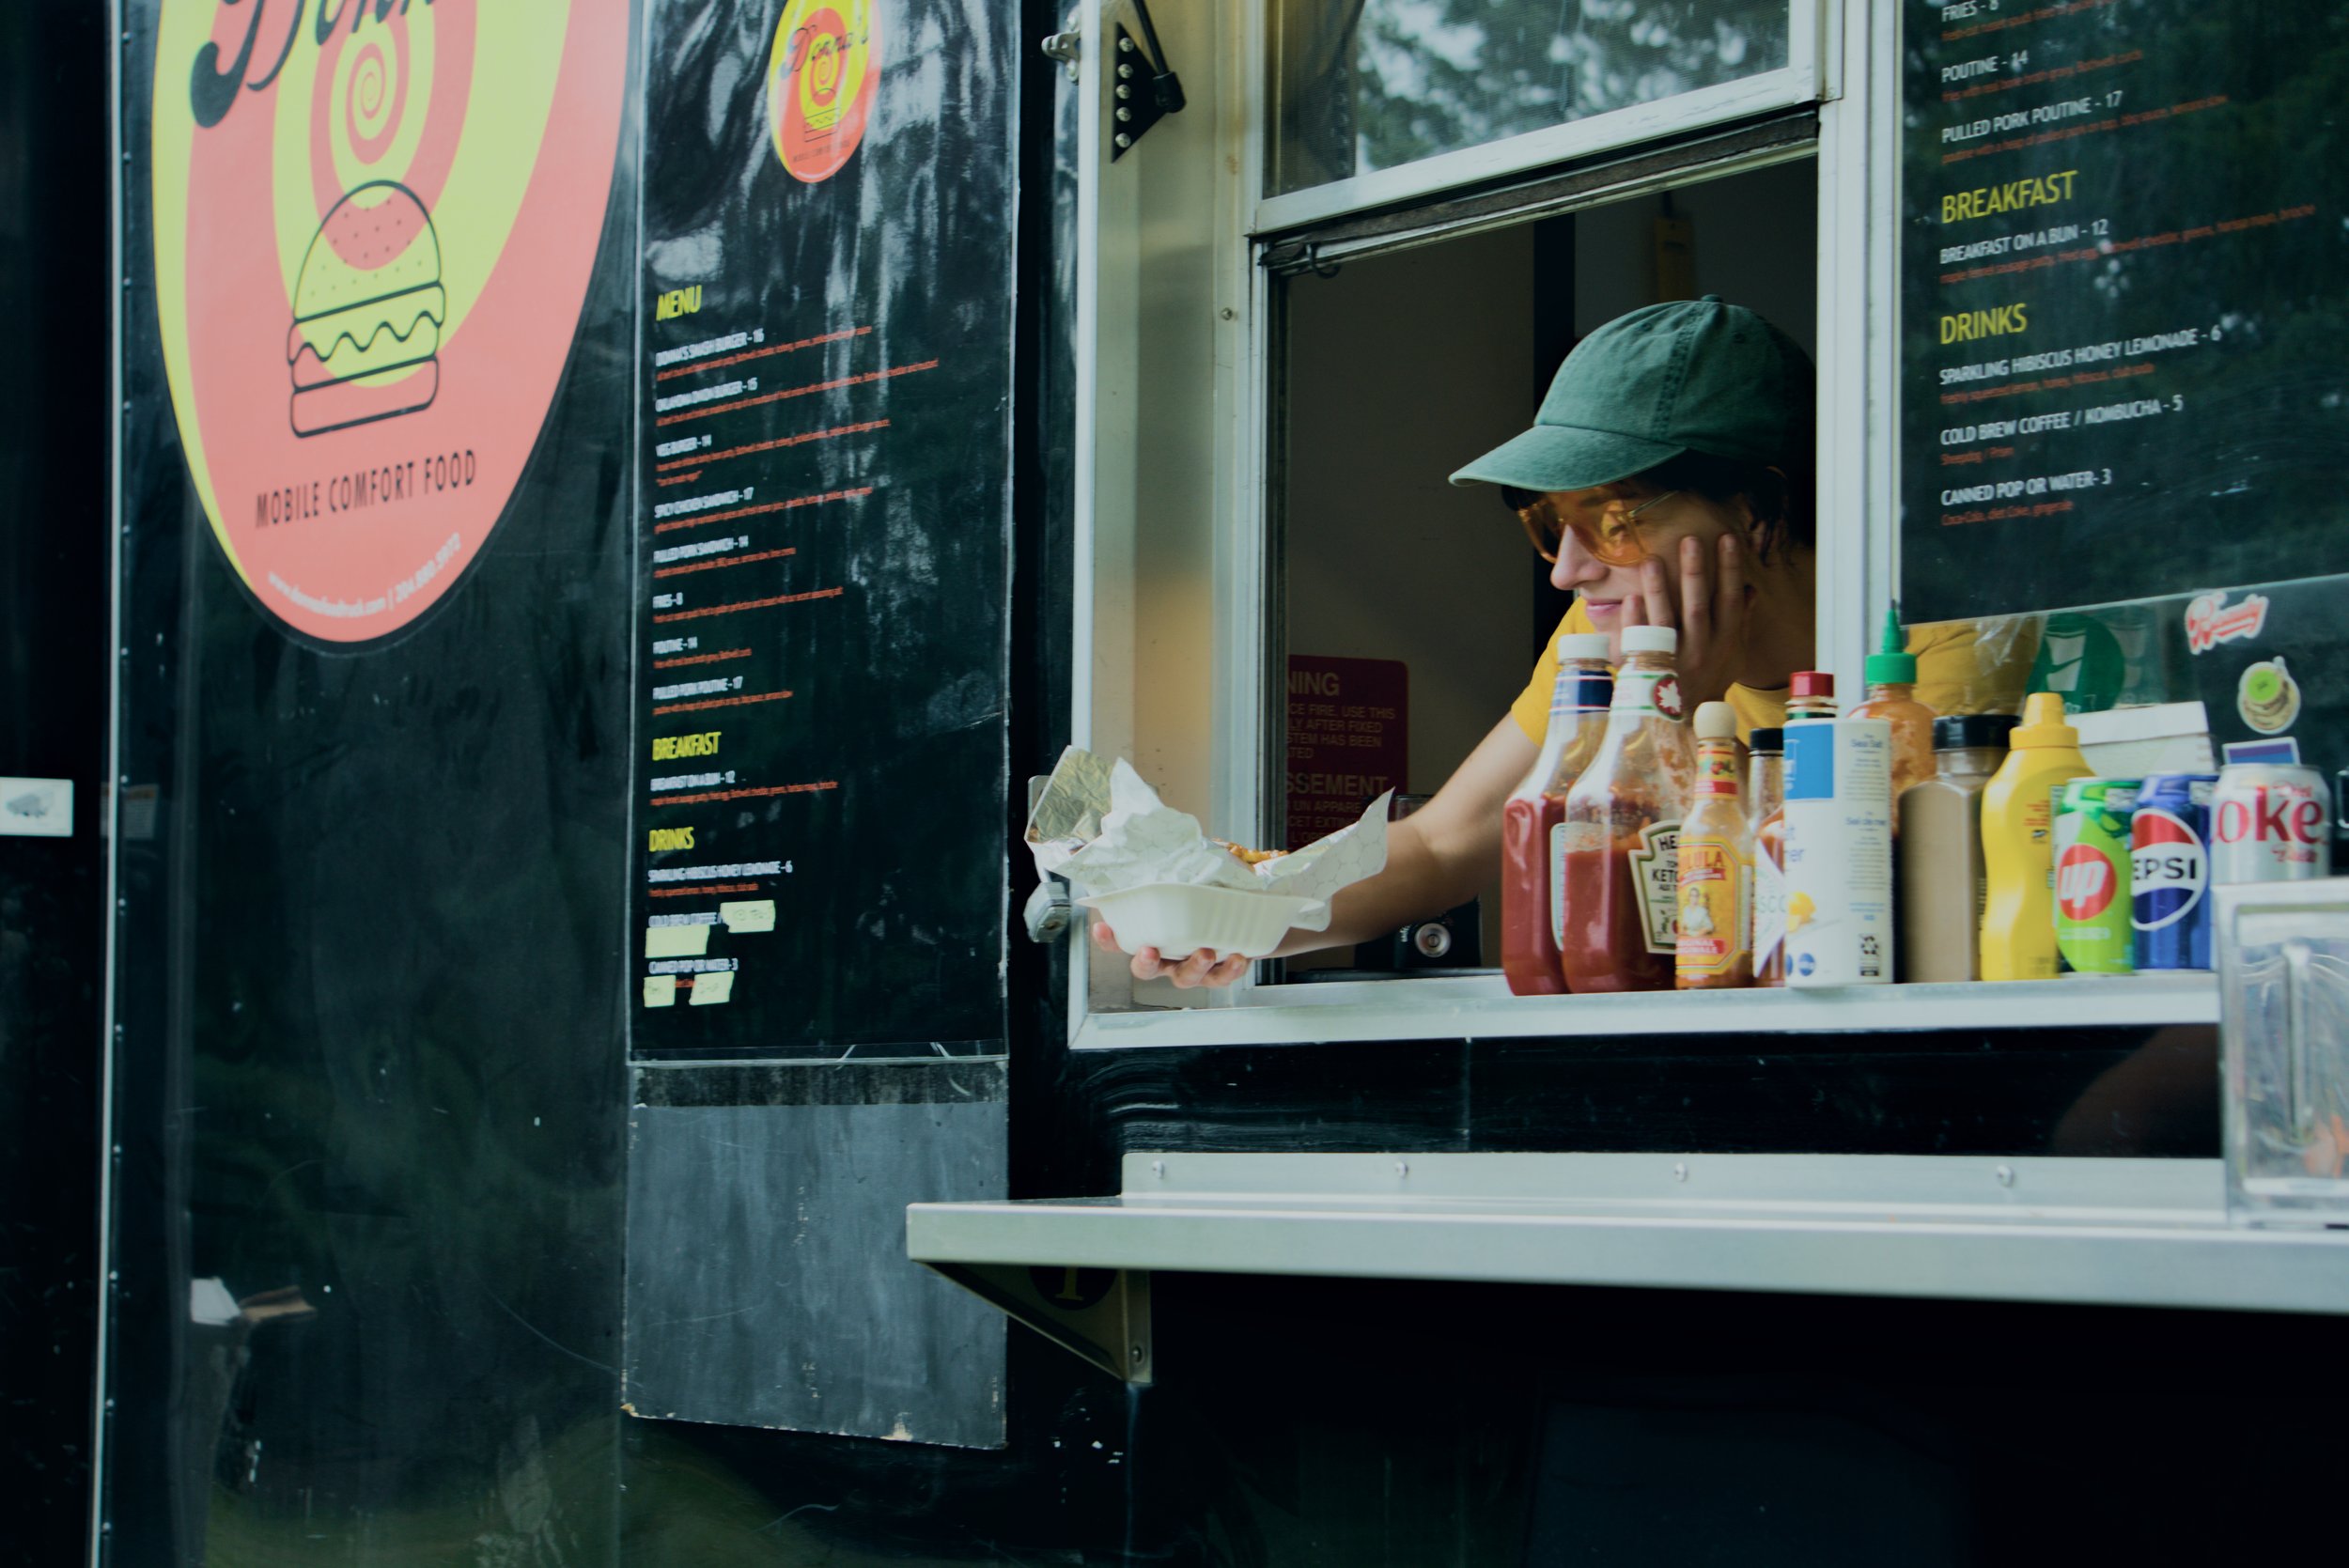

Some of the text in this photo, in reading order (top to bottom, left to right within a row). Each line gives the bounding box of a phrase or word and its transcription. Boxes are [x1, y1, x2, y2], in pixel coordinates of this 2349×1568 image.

[1942, 1, 1977, 22] FRIES
[1941, 55, 1999, 83] POUTINE
[2012, 50, 2029, 68] 14
[1942, 119, 1990, 143] PULLED
[1993, 111, 2030, 132] PORK
[2032, 97, 2092, 124] POUTINE
[2106, 90, 2123, 108] 17
[1941, 170, 2078, 224] BREAKFAST
[1939, 237, 2012, 264] BREAKFAST
[2013, 232, 2034, 250] ON
[2036, 232, 2047, 246] A
[2048, 225, 2078, 243] BUN
[2092, 219, 2108, 235] 12
[656, 285, 702, 321] MENU
[1940, 303, 2028, 345] DRINKS
[1939, 359, 2009, 385] SPARKLING
[2011, 349, 2072, 374] HIBISCUS
[2074, 341, 2122, 364] HONEY
[2124, 328, 2199, 356] LEMONADE
[2210, 324, 2221, 341] 6
[1940, 426, 1976, 445] COLD
[1978, 420, 2016, 440] BREW
[2019, 411, 2071, 434] COFFEE
[2085, 399, 2162, 424] KOMBUCHA
[2172, 395, 2184, 411] 5
[256, 449, 475, 529] MOBILE COMFORT FOOD
[1941, 485, 1995, 505] CANNED
[1996, 480, 2025, 498] POP
[2026, 477, 2047, 494] OR
[2102, 469, 2111, 485] 3
[1307, 719, 1346, 731] AFTER
[1348, 721, 1383, 733] FIXED
[1368, 707, 1395, 720] THIS
[653, 731, 722, 761] BREAKFAST
[1321, 735, 1346, 746] HAS
[1348, 736, 1382, 748] BEEN
[648, 827, 694, 852] DRINKS
[2060, 861, 2108, 908] up
